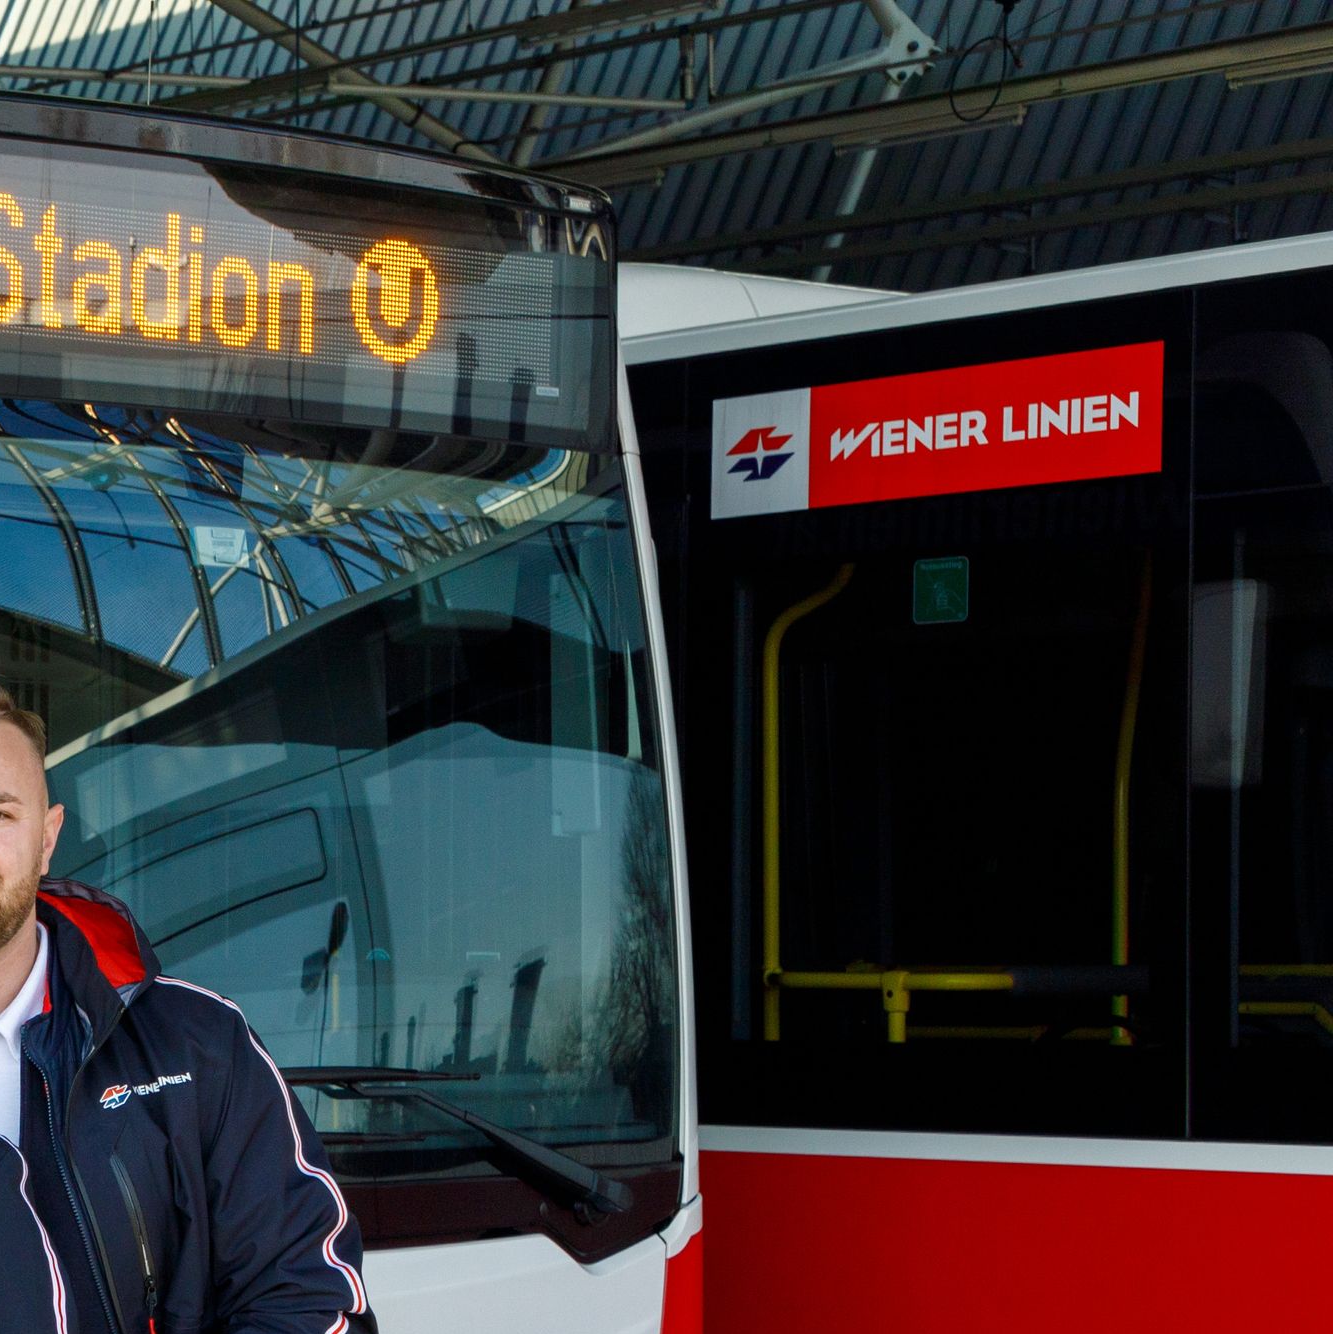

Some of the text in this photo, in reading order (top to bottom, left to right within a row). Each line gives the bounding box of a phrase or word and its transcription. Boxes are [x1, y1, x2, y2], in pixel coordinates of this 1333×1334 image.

[829, 390, 1140, 462] WIENER LINIEN
[157, 1072, 192, 1087] INIEN
